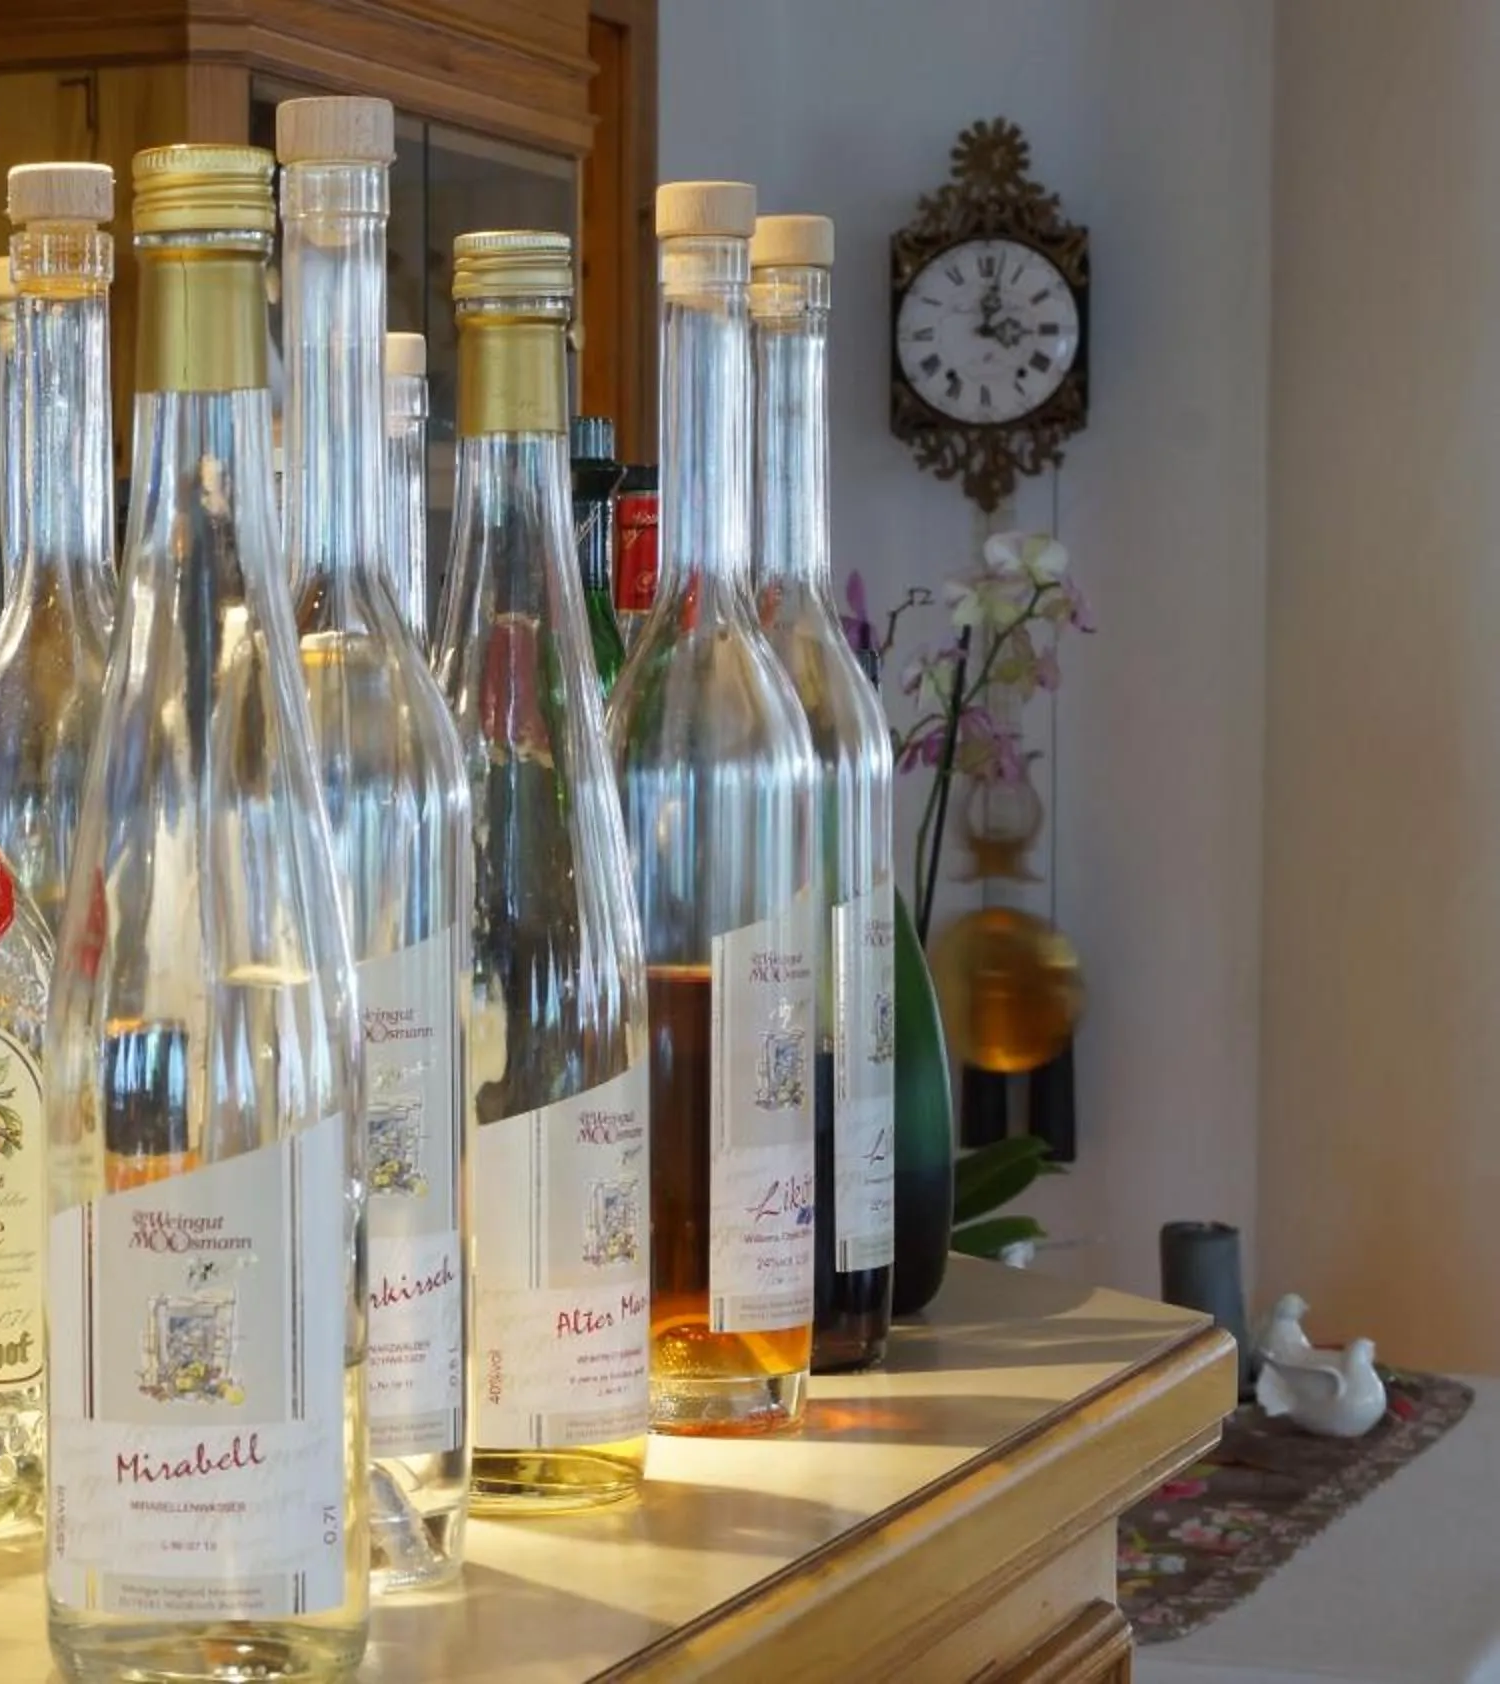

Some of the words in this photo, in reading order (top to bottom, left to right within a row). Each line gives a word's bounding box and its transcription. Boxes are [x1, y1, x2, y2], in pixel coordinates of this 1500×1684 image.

[363, 1007, 414, 1025] eingut
[146, 1211, 225, 1235] Weingut
[557, 1307, 615, 1339] Alter
[115, 1432, 268, 1486] Mirabell
